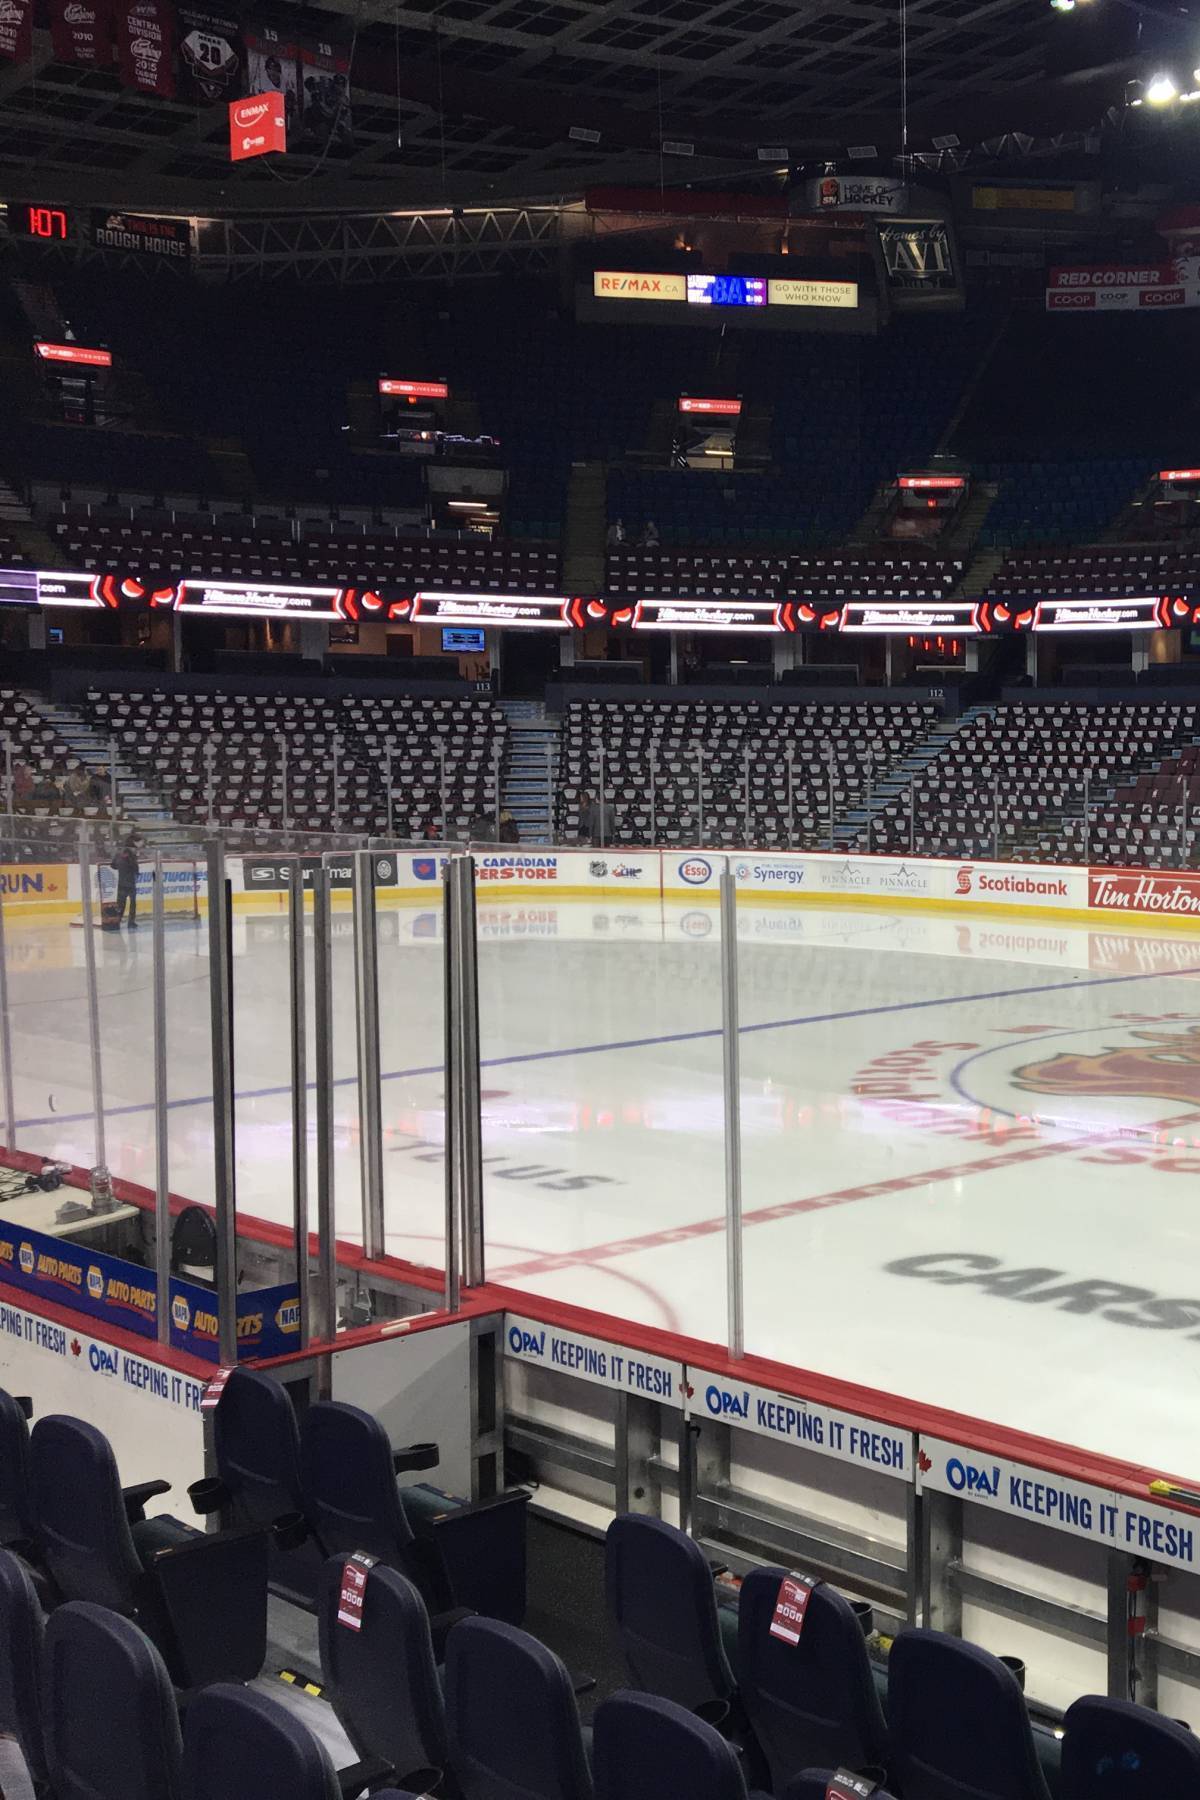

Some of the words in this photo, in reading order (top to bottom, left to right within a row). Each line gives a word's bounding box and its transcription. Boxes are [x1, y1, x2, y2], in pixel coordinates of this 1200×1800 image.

[127, 15, 161, 32] CENTRAL
[128, 26, 161, 41] DIVISION
[264, 28, 278, 42] 15
[200, 43, 221, 66] 20
[318, 42, 332, 56] 19
[136, 59, 157, 72] 2015
[240, 104, 269, 118] ENMAX
[844, 184, 873, 194] HOME
[844, 194, 894, 206] HOCKEY
[880, 226, 925, 242] Homes
[96, 228, 140, 250] ROUGH
[144, 237, 186, 257] HOUSE
[891, 241, 948, 271] AVI
[1058, 272, 1089, 286] RED
[1092, 270, 1160, 284] CORNER
[775, 284, 789, 292] GO
[793, 285, 817, 293] WITH
[821, 286, 851, 295] THOSE
[785, 293, 808, 302] WHO
[811, 294, 841, 303] KNOW
[476, 682, 490, 690] 113
[930, 688, 944, 697] 112
[483, 858, 557, 867] CANADIAN
[754, 867, 804, 884] Synergy
[822, 875, 871, 886] PINNACLE
[880, 878, 928, 888] PINNACLE
[979, 875, 1068, 896] Scotiabank
[1092, 875, 1131, 907] Tim
[37, 1254, 58, 1276] AUTO
[58, 1261, 82, 1285] PARTS
[107, 1279, 129, 1302] AUTO
[131, 1286, 156, 1312] PARTS
[174, 1304, 188, 1321] NAPA
[194, 1310, 219, 1336] AUTO
[25, 1317, 33, 1342] IT
[36, 1321, 66, 1356] FRESH
[509, 1327, 545, 1356] OPA!
[551, 1338, 606, 1377] KEEPING
[611, 1358, 622, 1382] IT
[628, 1363, 672, 1398] FRESH
[89, 1344, 118, 1375] OPA!
[124, 1359, 168, 1399] KEEPING
[172, 1373, 182, 1403] IT
[706, 1385, 749, 1419] OPA!
[757, 1399, 823, 1445] KEEPING
[829, 1423, 844, 1451] IT
[850, 1428, 903, 1470] FRESH
[946, 1458, 1001, 1497] OPA!
[1009, 1476, 1091, 1529] KEEPING
[1100, 1504, 1118, 1537] IT
[1125, 1513, 1193, 1562] FRESH
